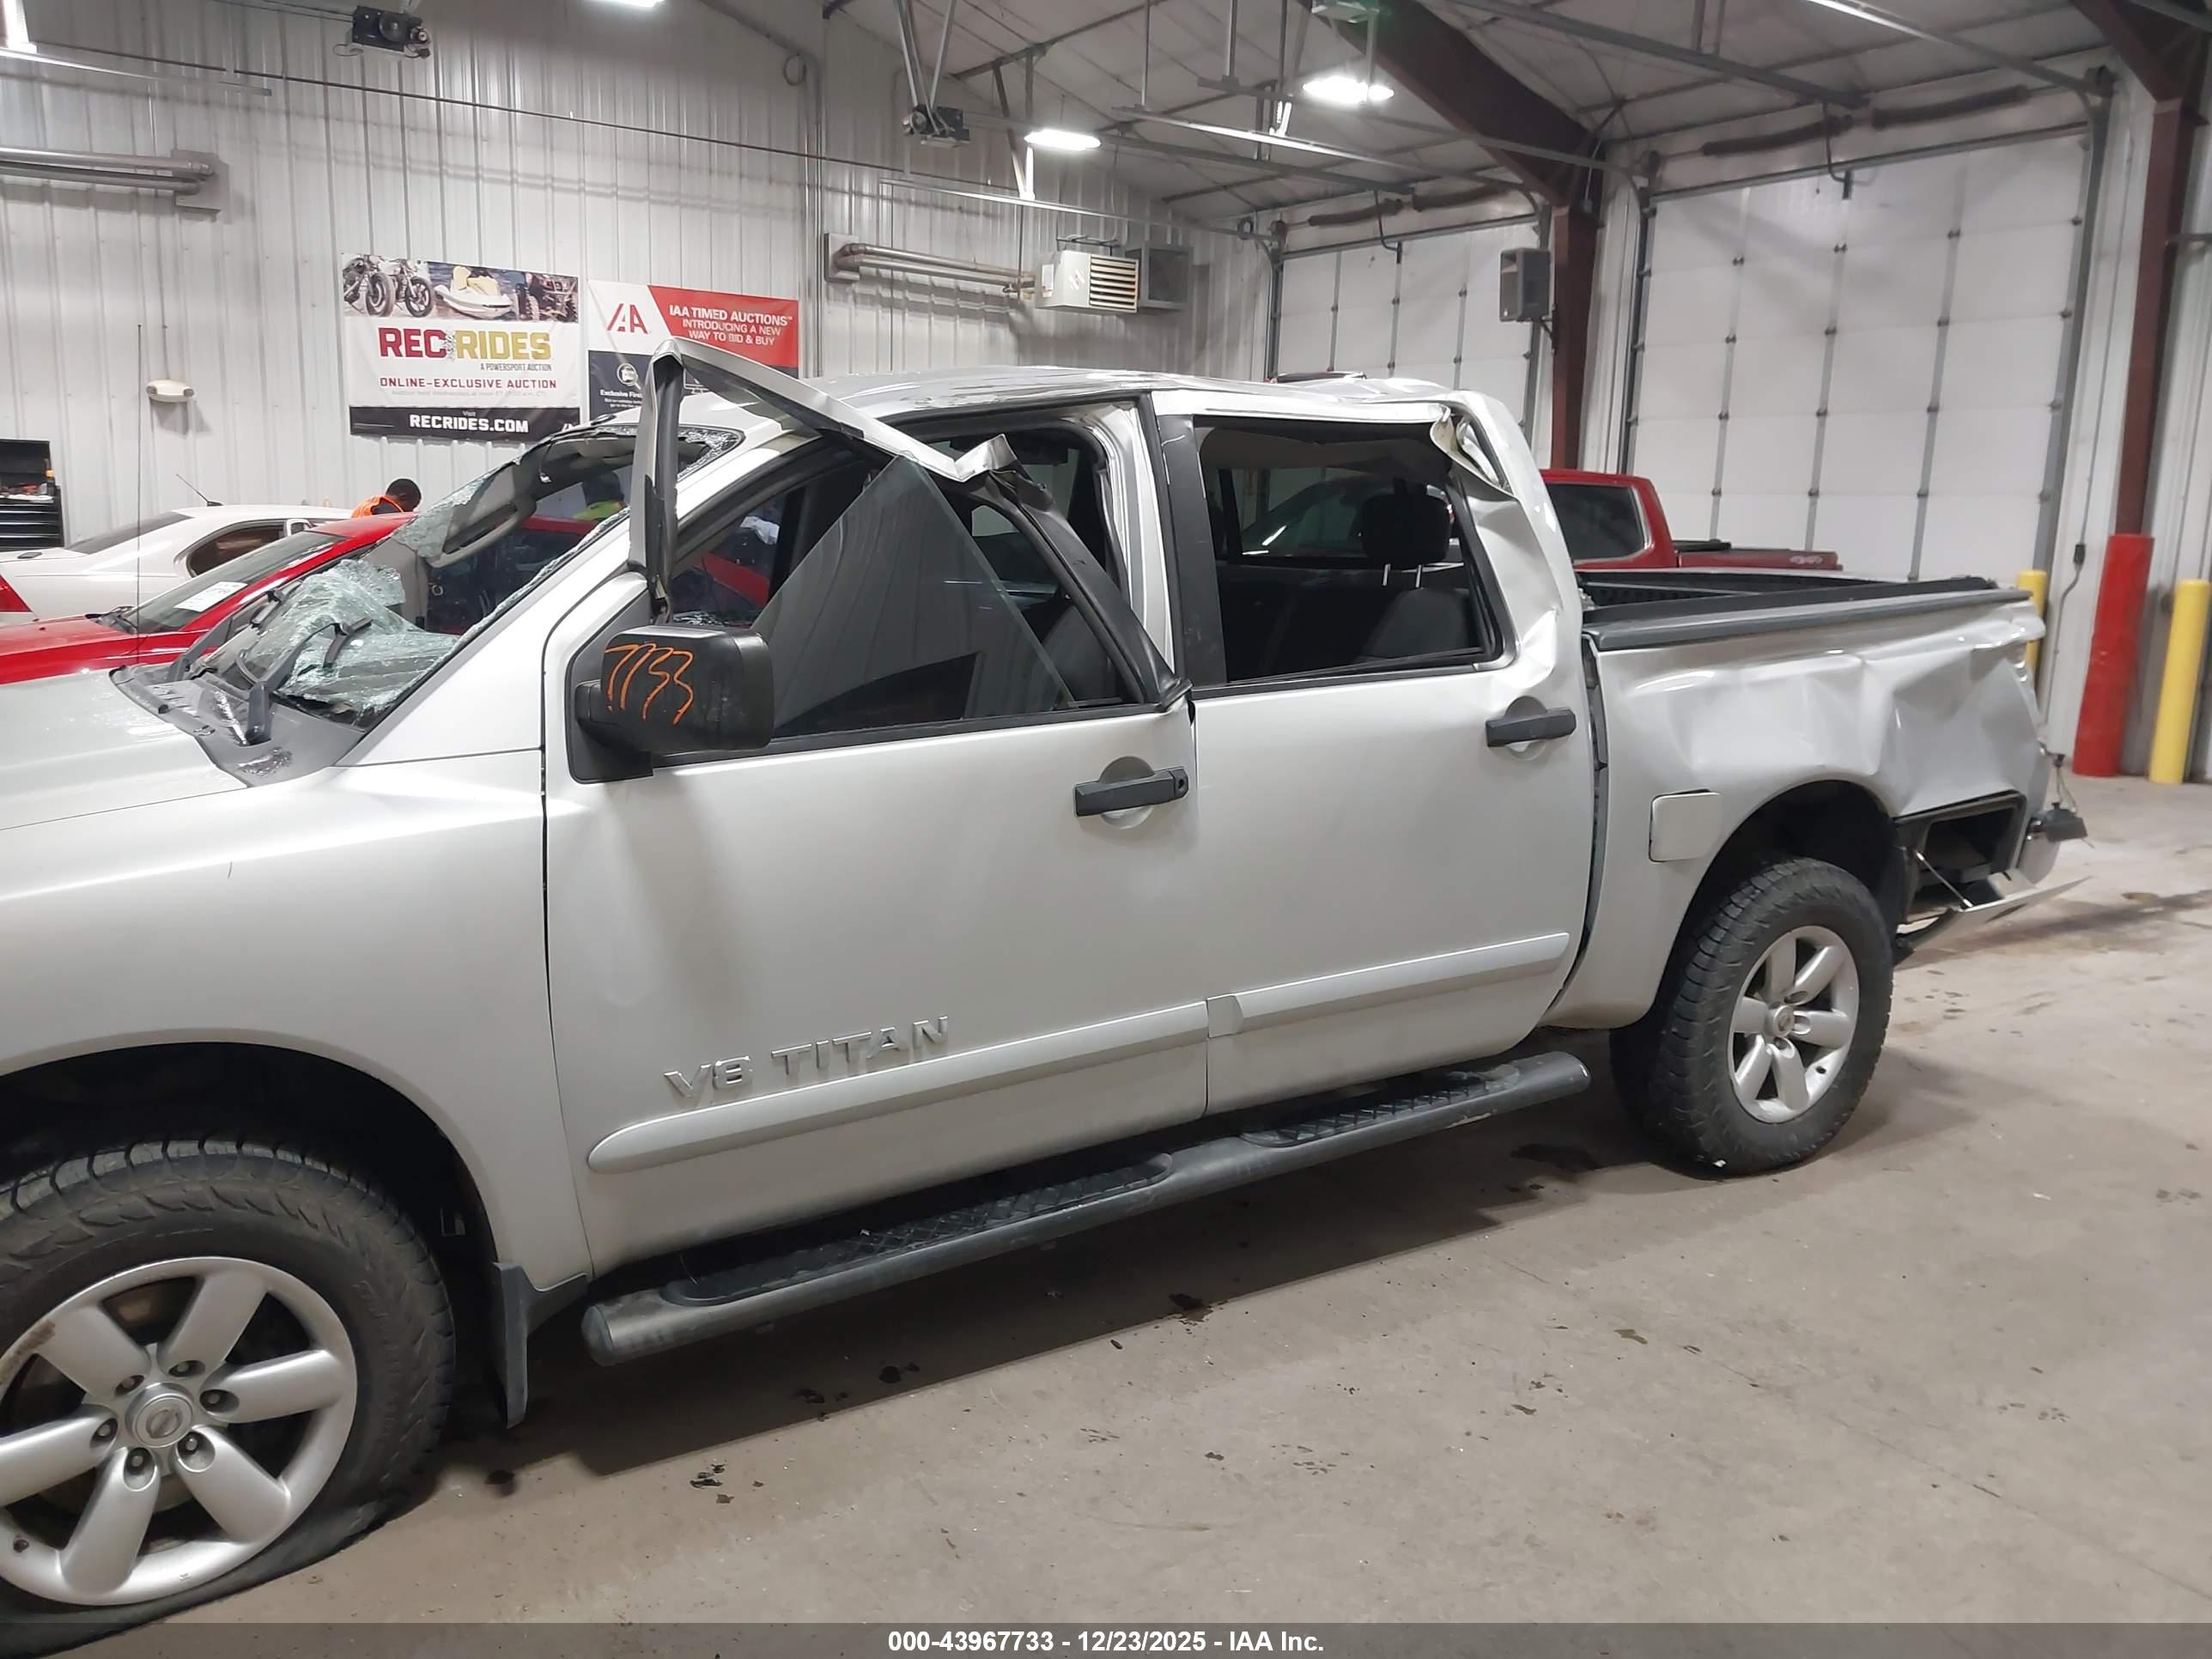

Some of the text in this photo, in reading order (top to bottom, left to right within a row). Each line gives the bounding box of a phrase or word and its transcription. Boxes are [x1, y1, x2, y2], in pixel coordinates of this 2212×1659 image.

[669, 305, 690, 318] IAA
[691, 307, 728, 320] TIMED
[683, 319, 781, 336] INTRODUCING A NEW
[689, 330, 775, 346] WAY TO BID & BUY
[486, 363, 526, 372] POWERSPORT
[527, 363, 552, 372] AUCTION
[380, 378, 557, 389] ONLINE-EXCLUSIVE AUCTION
[410, 414, 529, 434] RECRIDES.COM
[771, 1017, 948, 1075] TITAN
